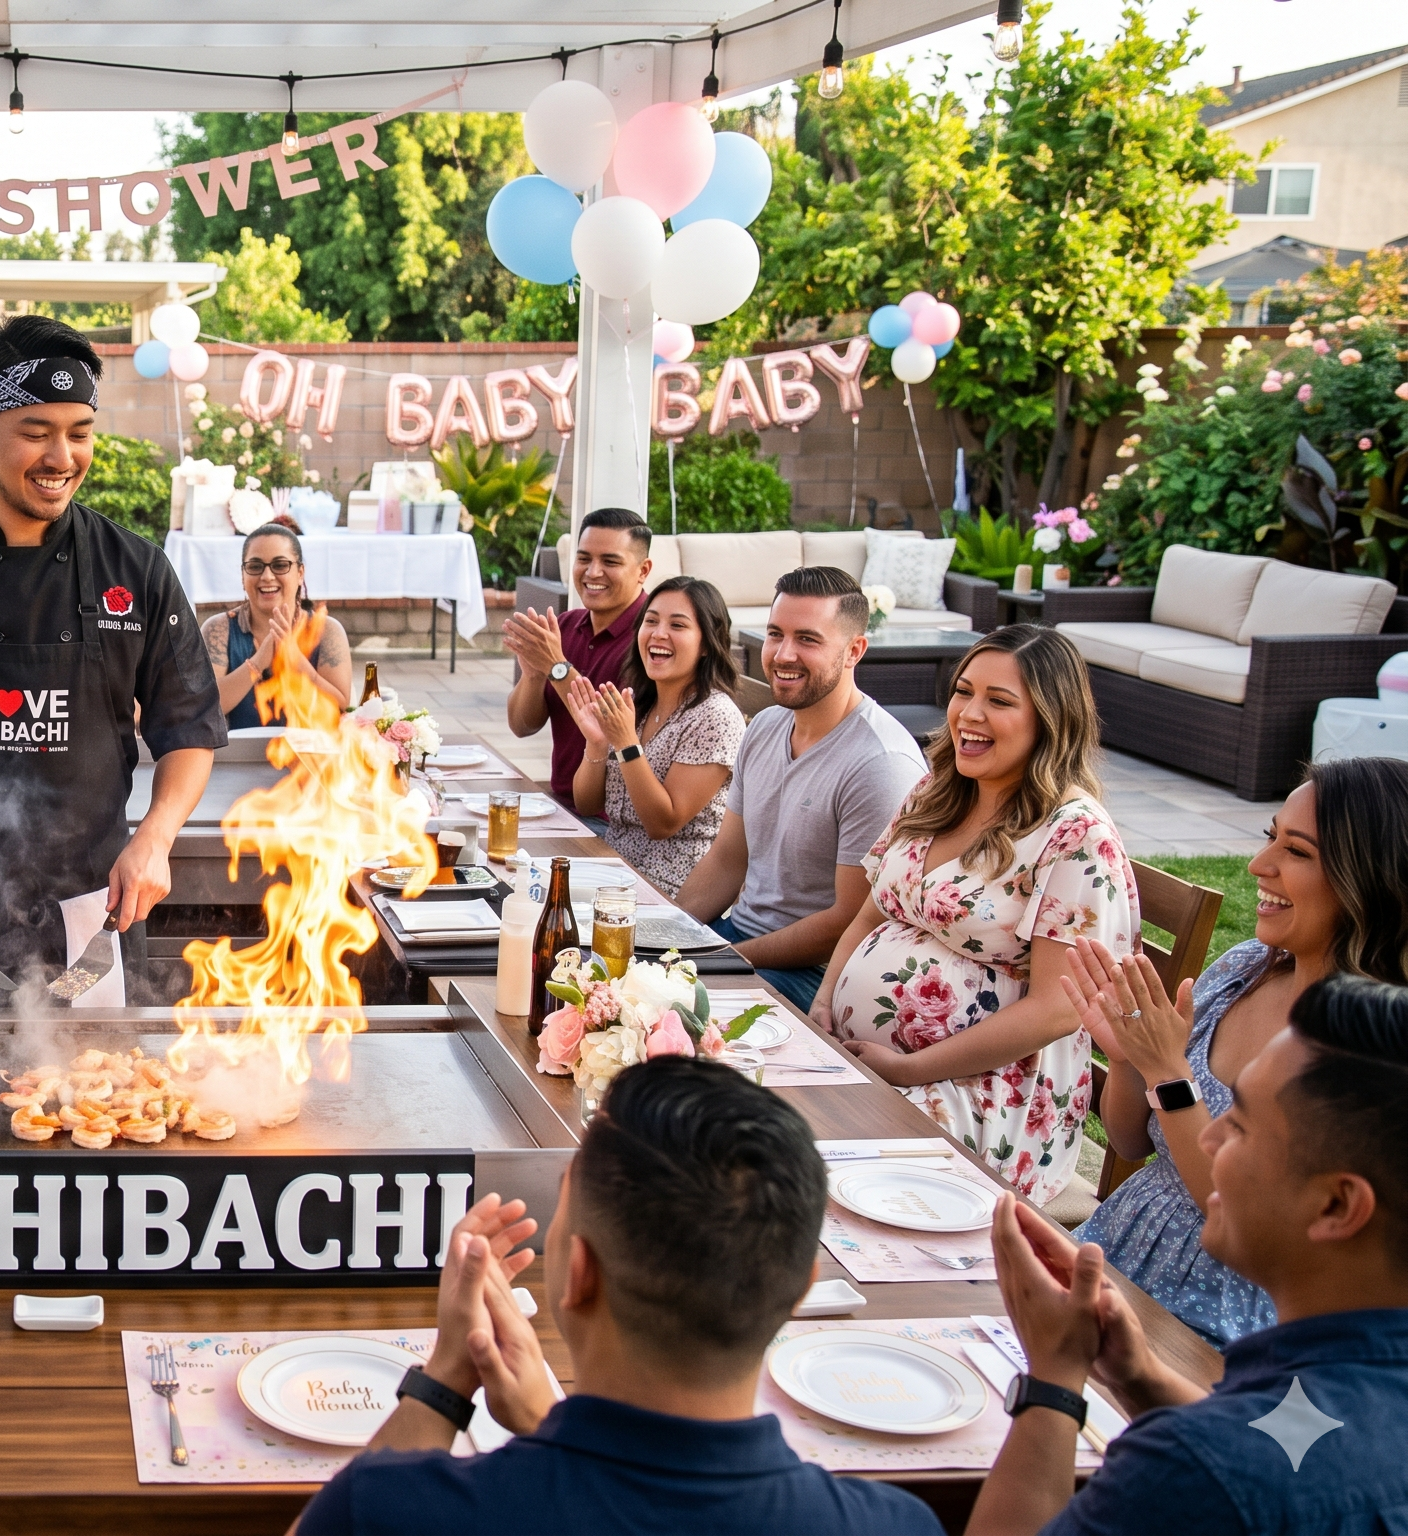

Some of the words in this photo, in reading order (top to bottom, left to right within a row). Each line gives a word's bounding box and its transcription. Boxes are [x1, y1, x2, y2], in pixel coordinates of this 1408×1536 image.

[239, 350, 346, 442] OH
[386, 357, 577, 452] BABY
[652, 337, 871, 441] BABY
[306, 1380, 373, 1401] Baby
